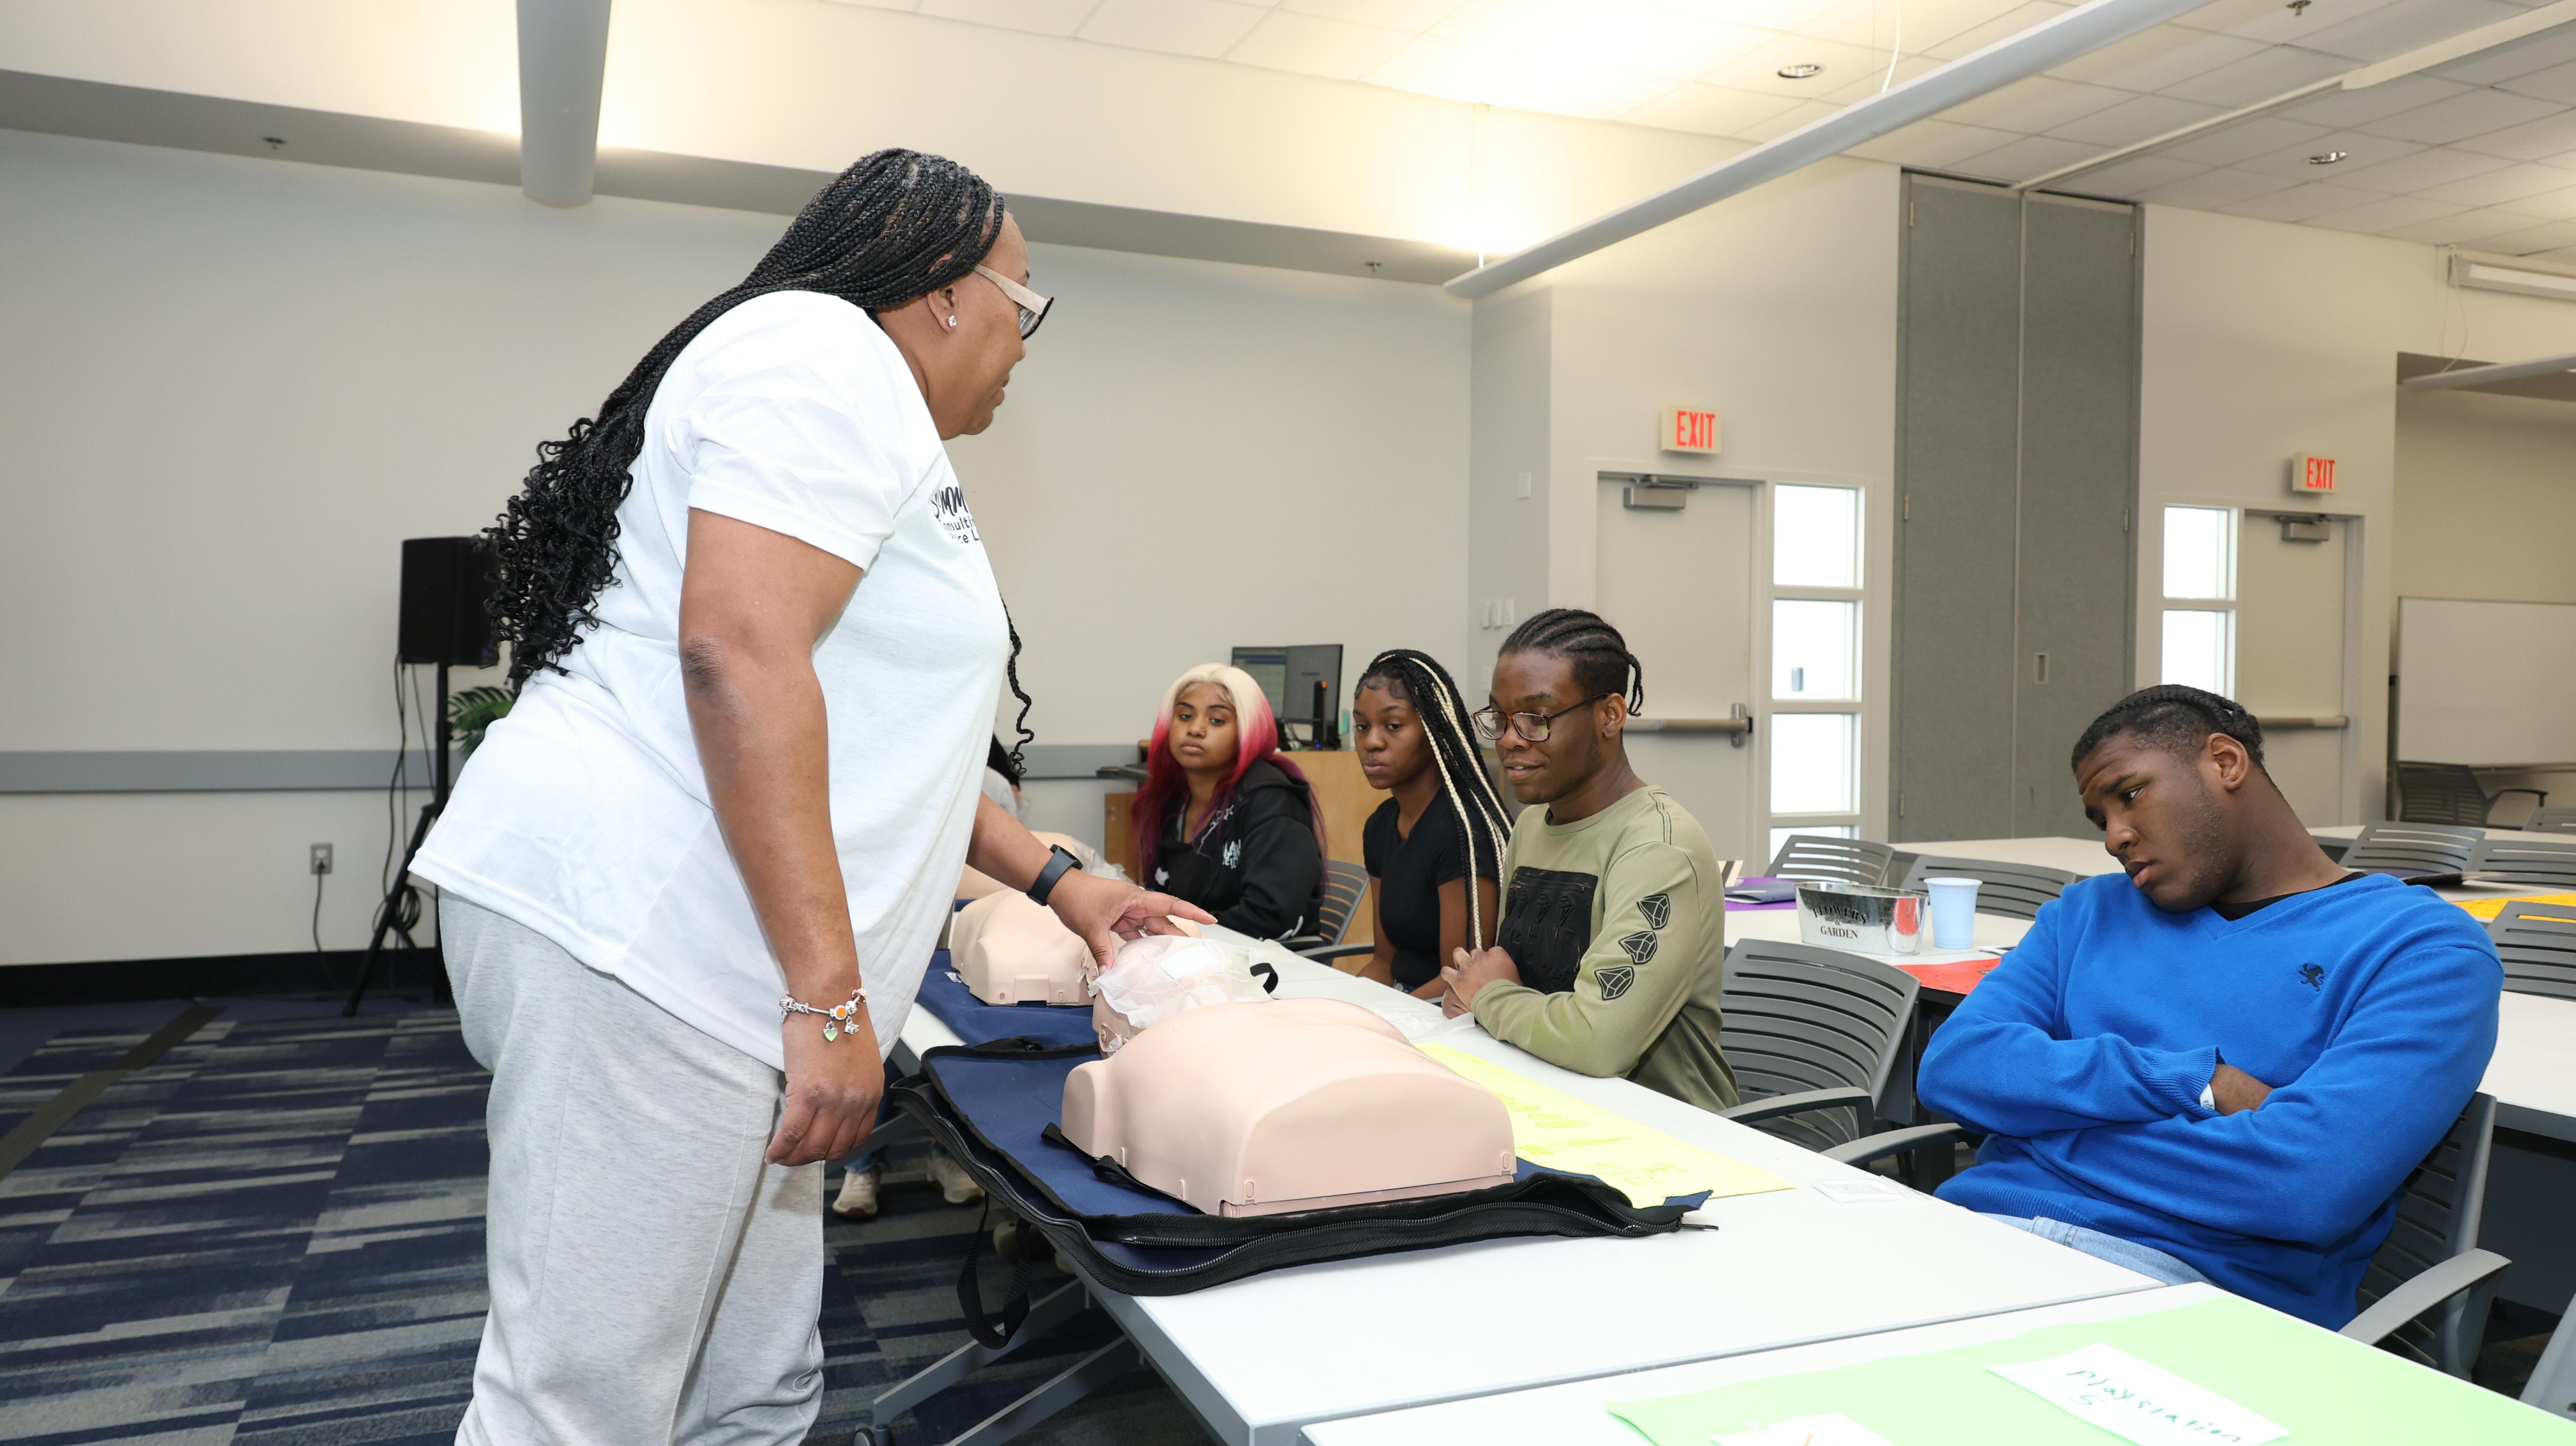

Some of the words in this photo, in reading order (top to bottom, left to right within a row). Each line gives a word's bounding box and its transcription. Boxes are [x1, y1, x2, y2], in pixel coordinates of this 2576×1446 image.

[1677, 410, 1716, 448] EXIT
[2307, 458, 2335, 489] EXIT
[1813, 904, 1867, 924] FLOWERS
[1820, 925, 1859, 939] GARDEN
